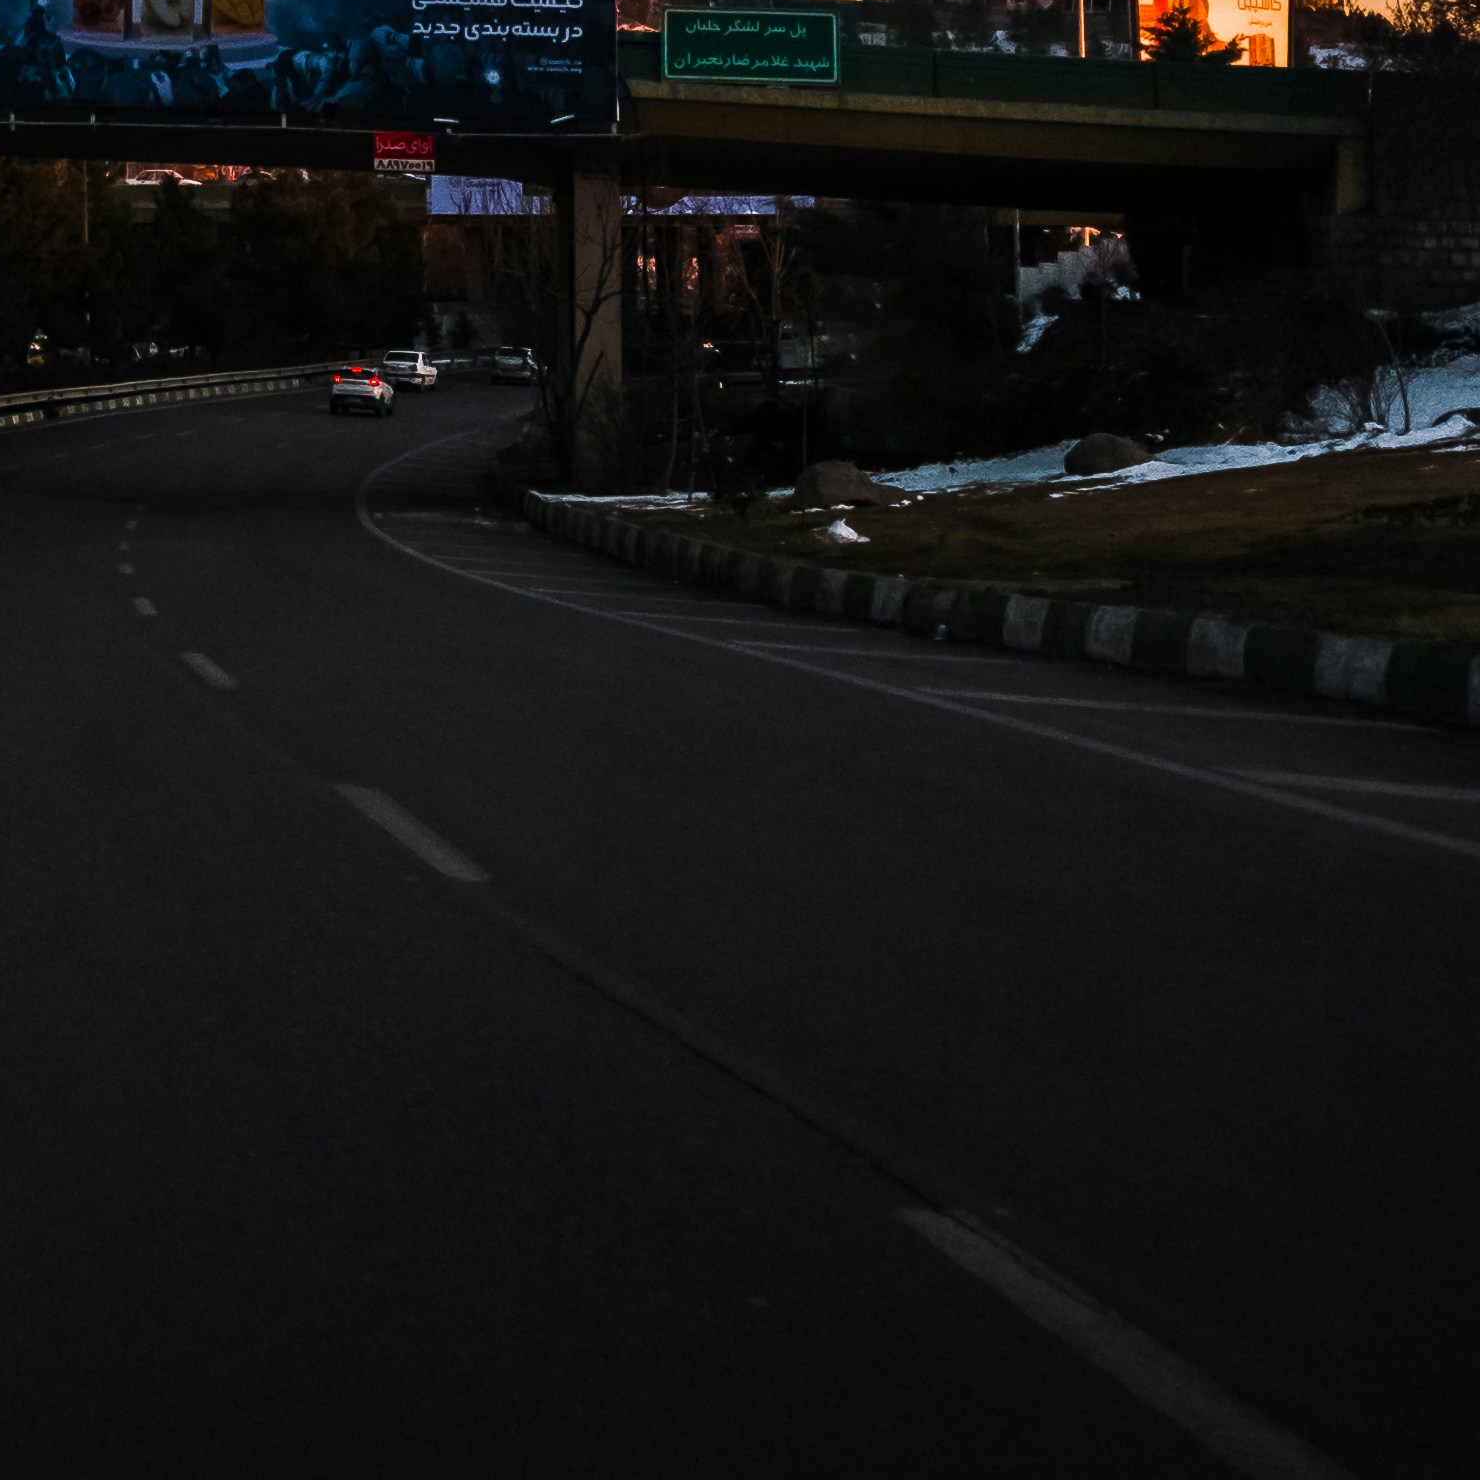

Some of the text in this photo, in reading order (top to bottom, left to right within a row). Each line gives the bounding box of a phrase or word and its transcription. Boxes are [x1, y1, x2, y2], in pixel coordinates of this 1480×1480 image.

[412, 21, 461, 40] جدید
[685, 19, 721, 34] خلبان
[789, 21, 807, 39] پل
[793, 55, 831, 72] شهید
[375, 135, 406, 154] صدرا
